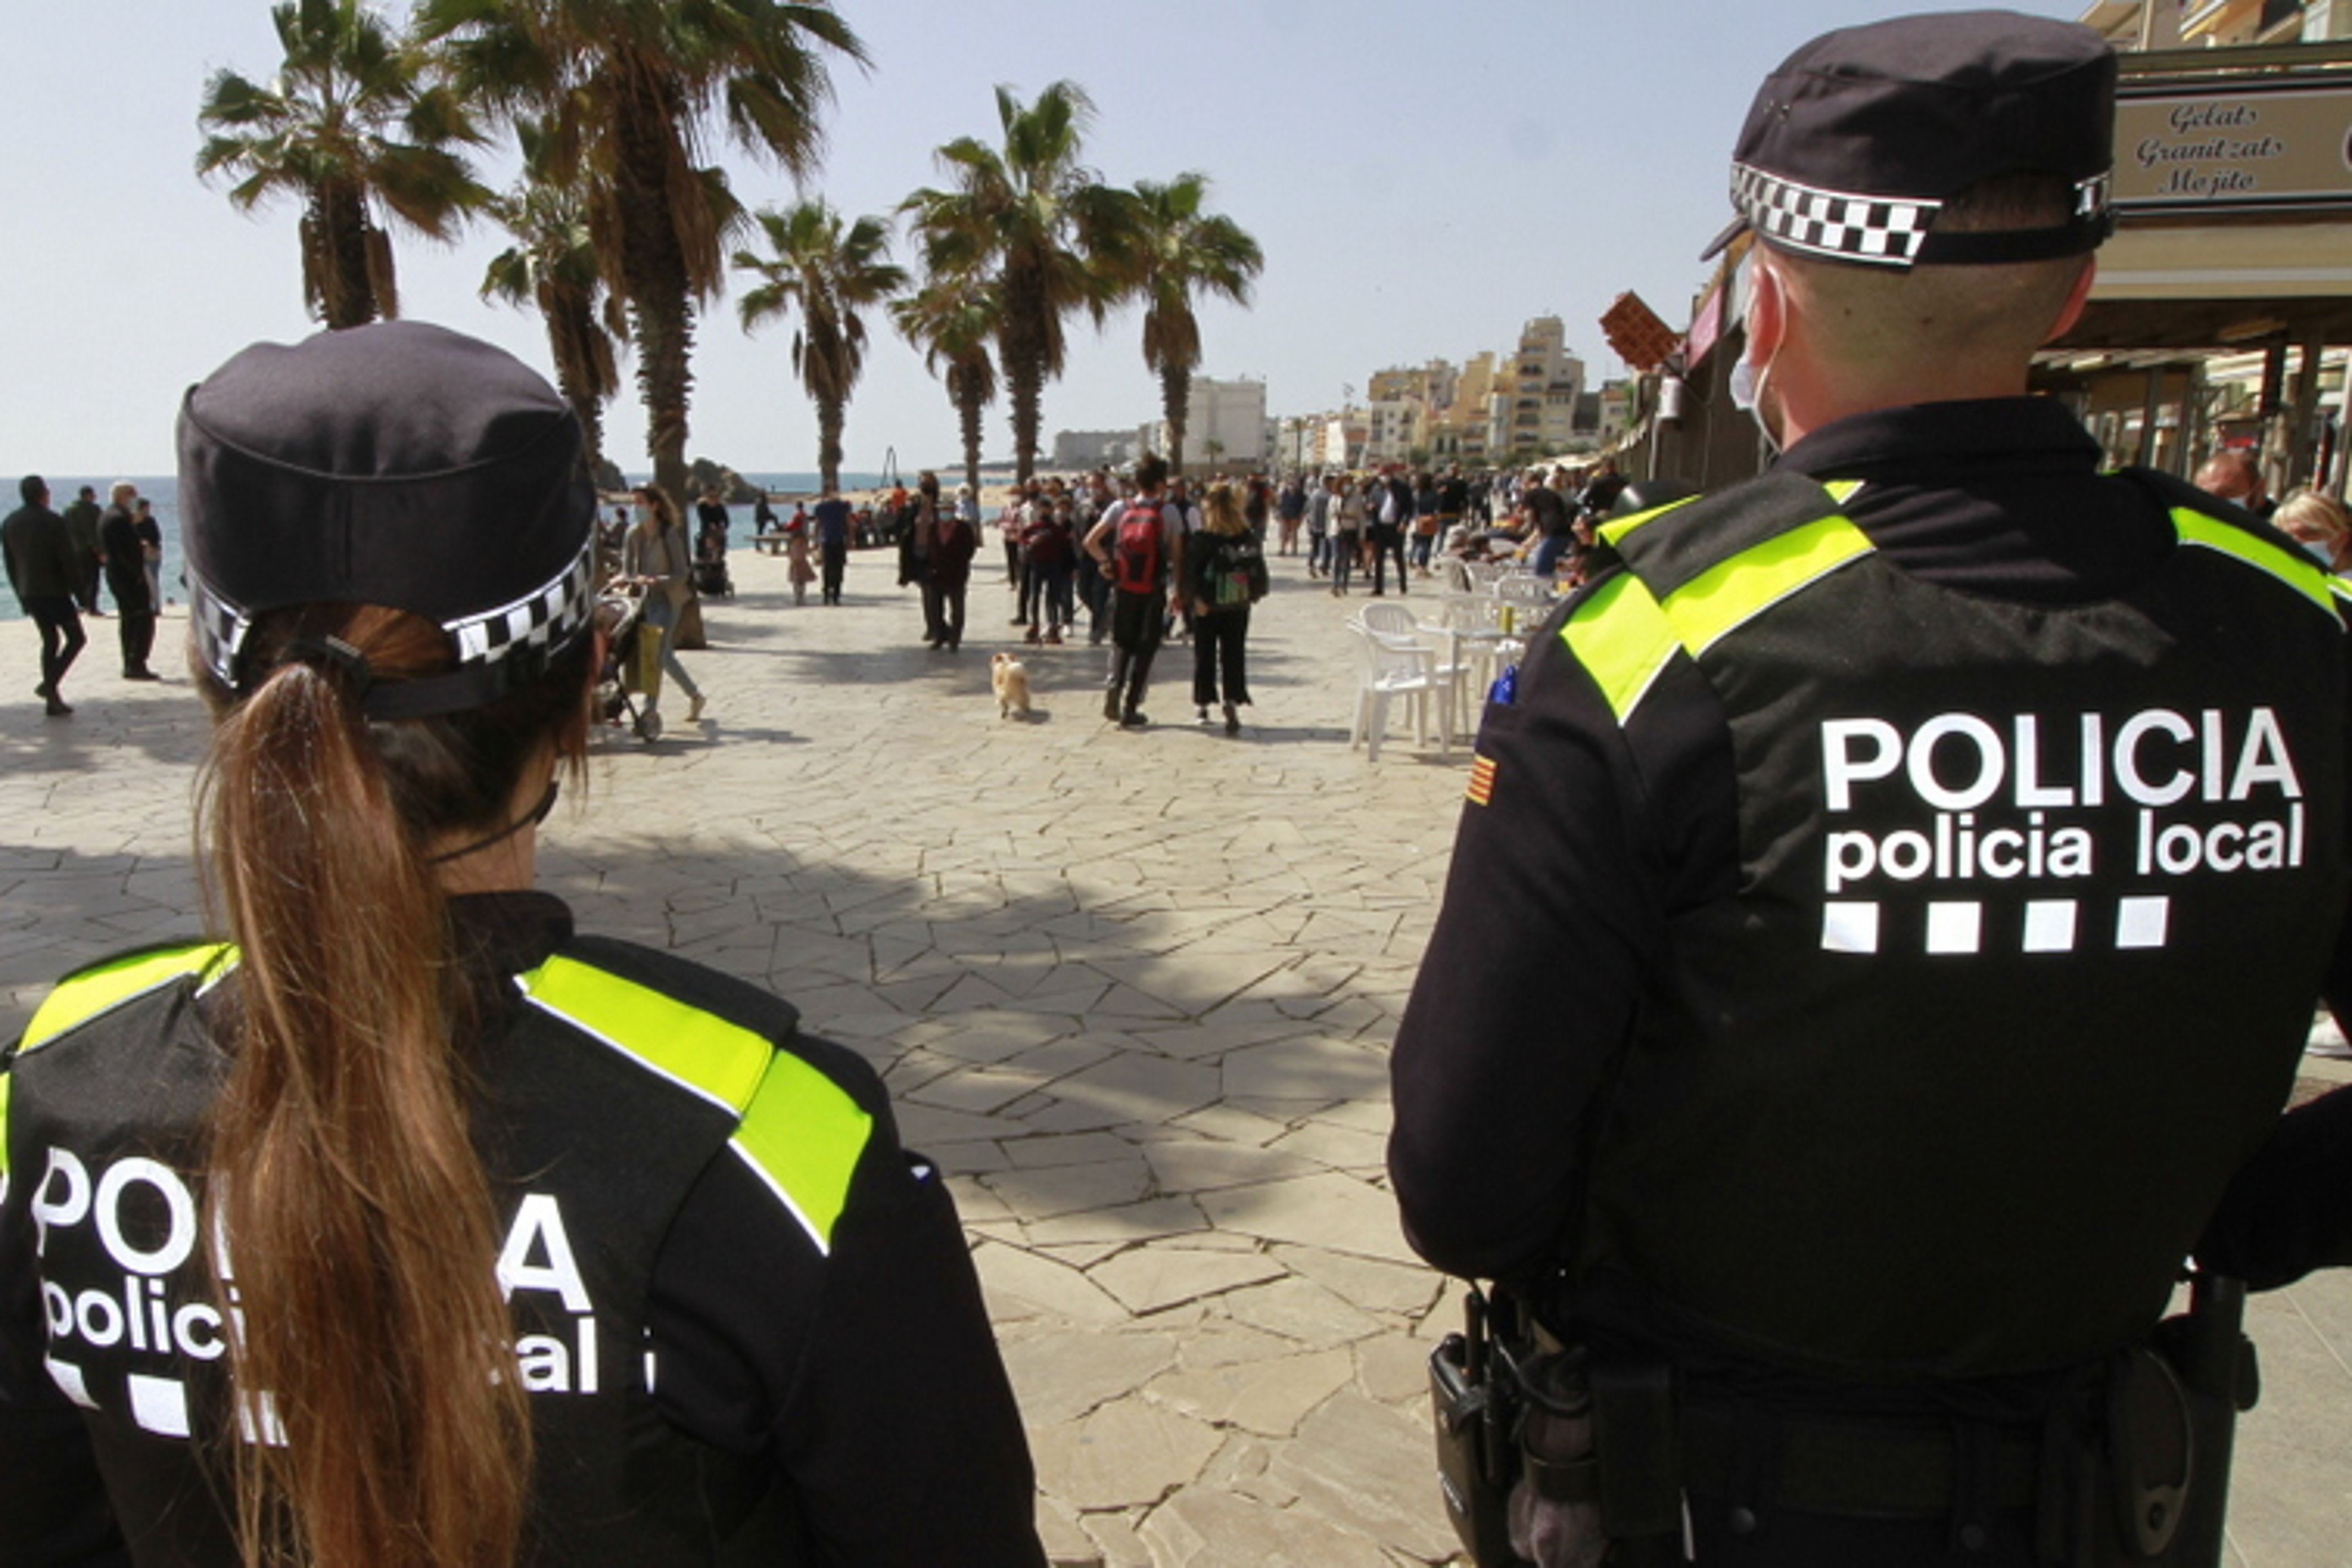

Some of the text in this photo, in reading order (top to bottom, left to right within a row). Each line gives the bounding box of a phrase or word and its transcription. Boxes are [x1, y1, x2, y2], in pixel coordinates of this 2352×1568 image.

[2170, 102, 2257, 134] Gelats
[2137, 137, 2282, 168] Granitzats
[2158, 167, 2253, 197] Mojito
[1821, 707, 2302, 812] POLICIA
[1825, 802, 2304, 894] policia local
